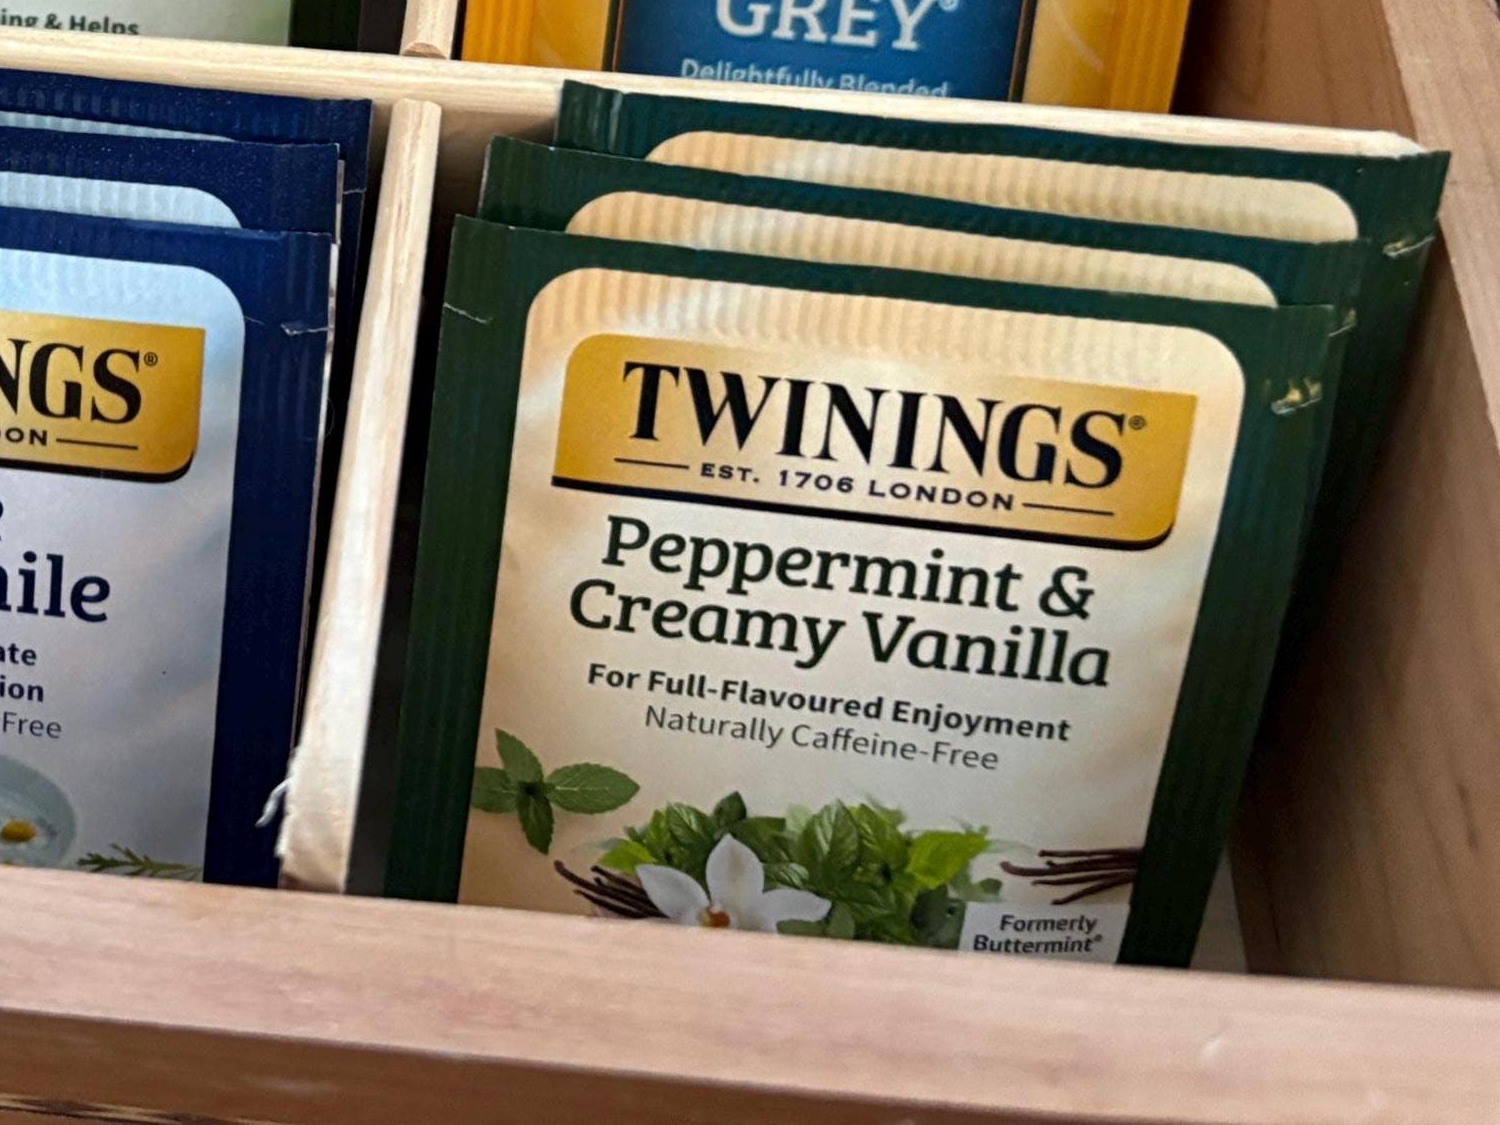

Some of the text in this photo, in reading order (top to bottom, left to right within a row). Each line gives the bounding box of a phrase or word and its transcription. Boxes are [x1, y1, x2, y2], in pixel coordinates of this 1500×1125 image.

[43, 13, 61, 29] &
[699, 463, 1014, 512] EST. 1706 LONDON
[601, 514, 1095, 621] Peppermint &
[568, 577, 1111, 689] Creamy Vanilla
[587, 661, 1071, 744] For Full-Flavoured Enjoyment
[643, 703, 999, 772] Naturally Caffeine-Free
[999, 914, 1098, 935] Formerly
